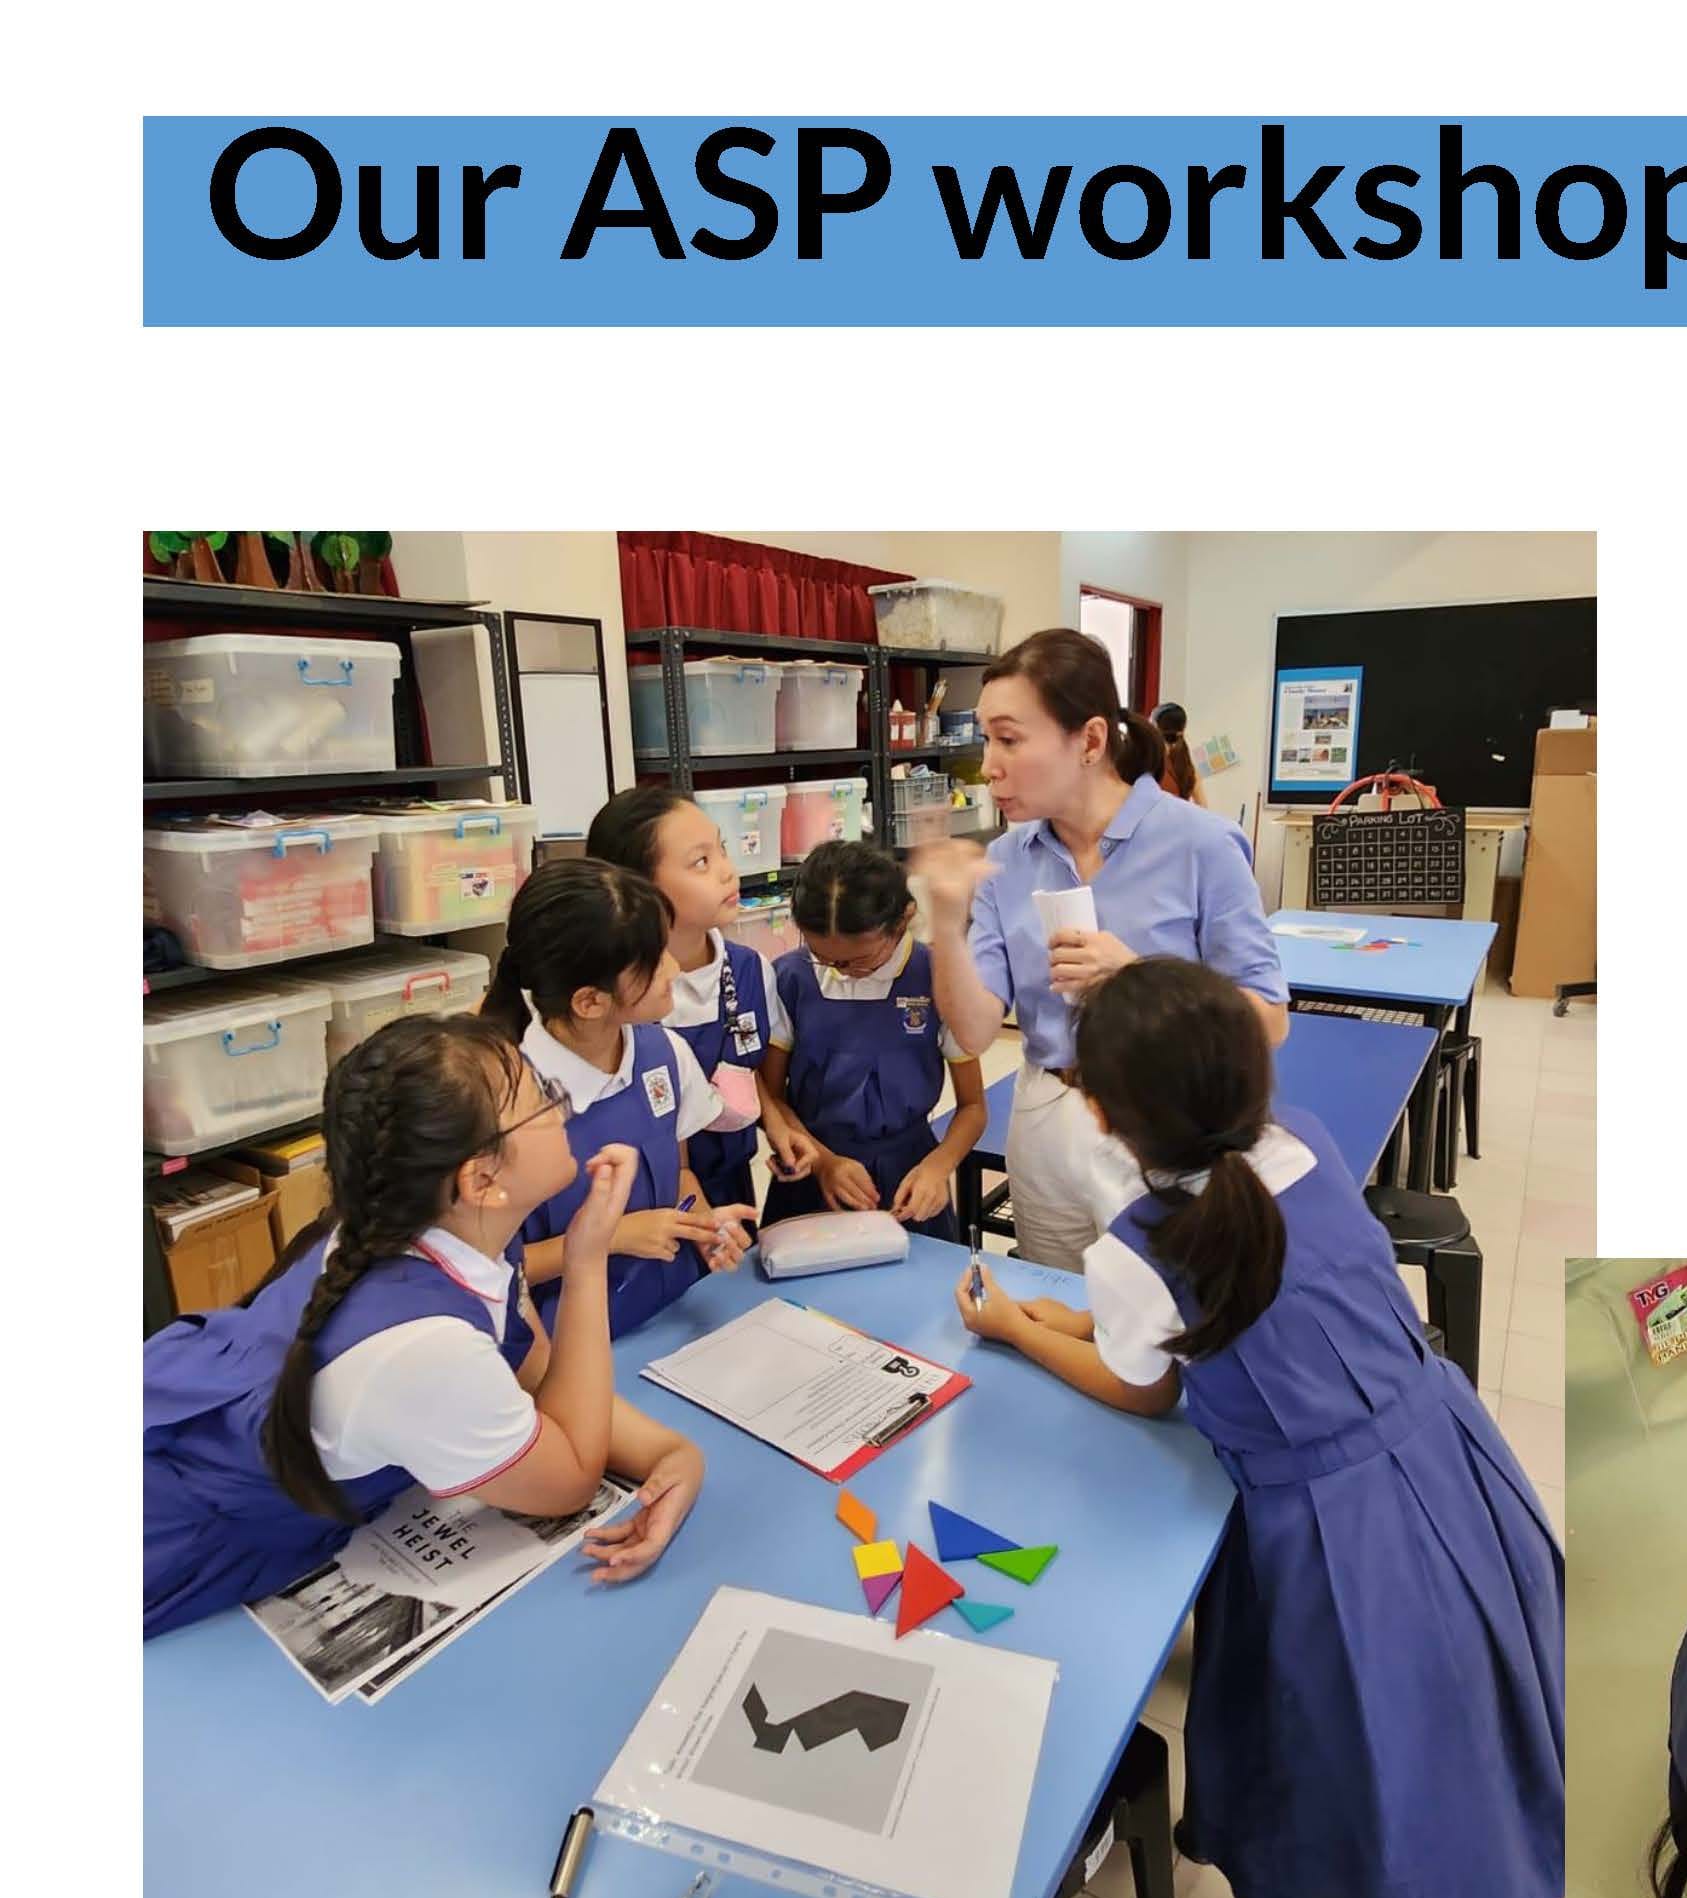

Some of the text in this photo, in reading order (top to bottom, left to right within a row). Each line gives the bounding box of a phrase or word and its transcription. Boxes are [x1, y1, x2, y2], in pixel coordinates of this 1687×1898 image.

[1350, 812, 1424, 827] PARKING LOT
[1636, 1282, 1670, 1309] TYG
[411, 1508, 478, 1561] JEWEL
[448, 1509, 480, 1535] THE
[391, 1524, 454, 1571] HEIST
